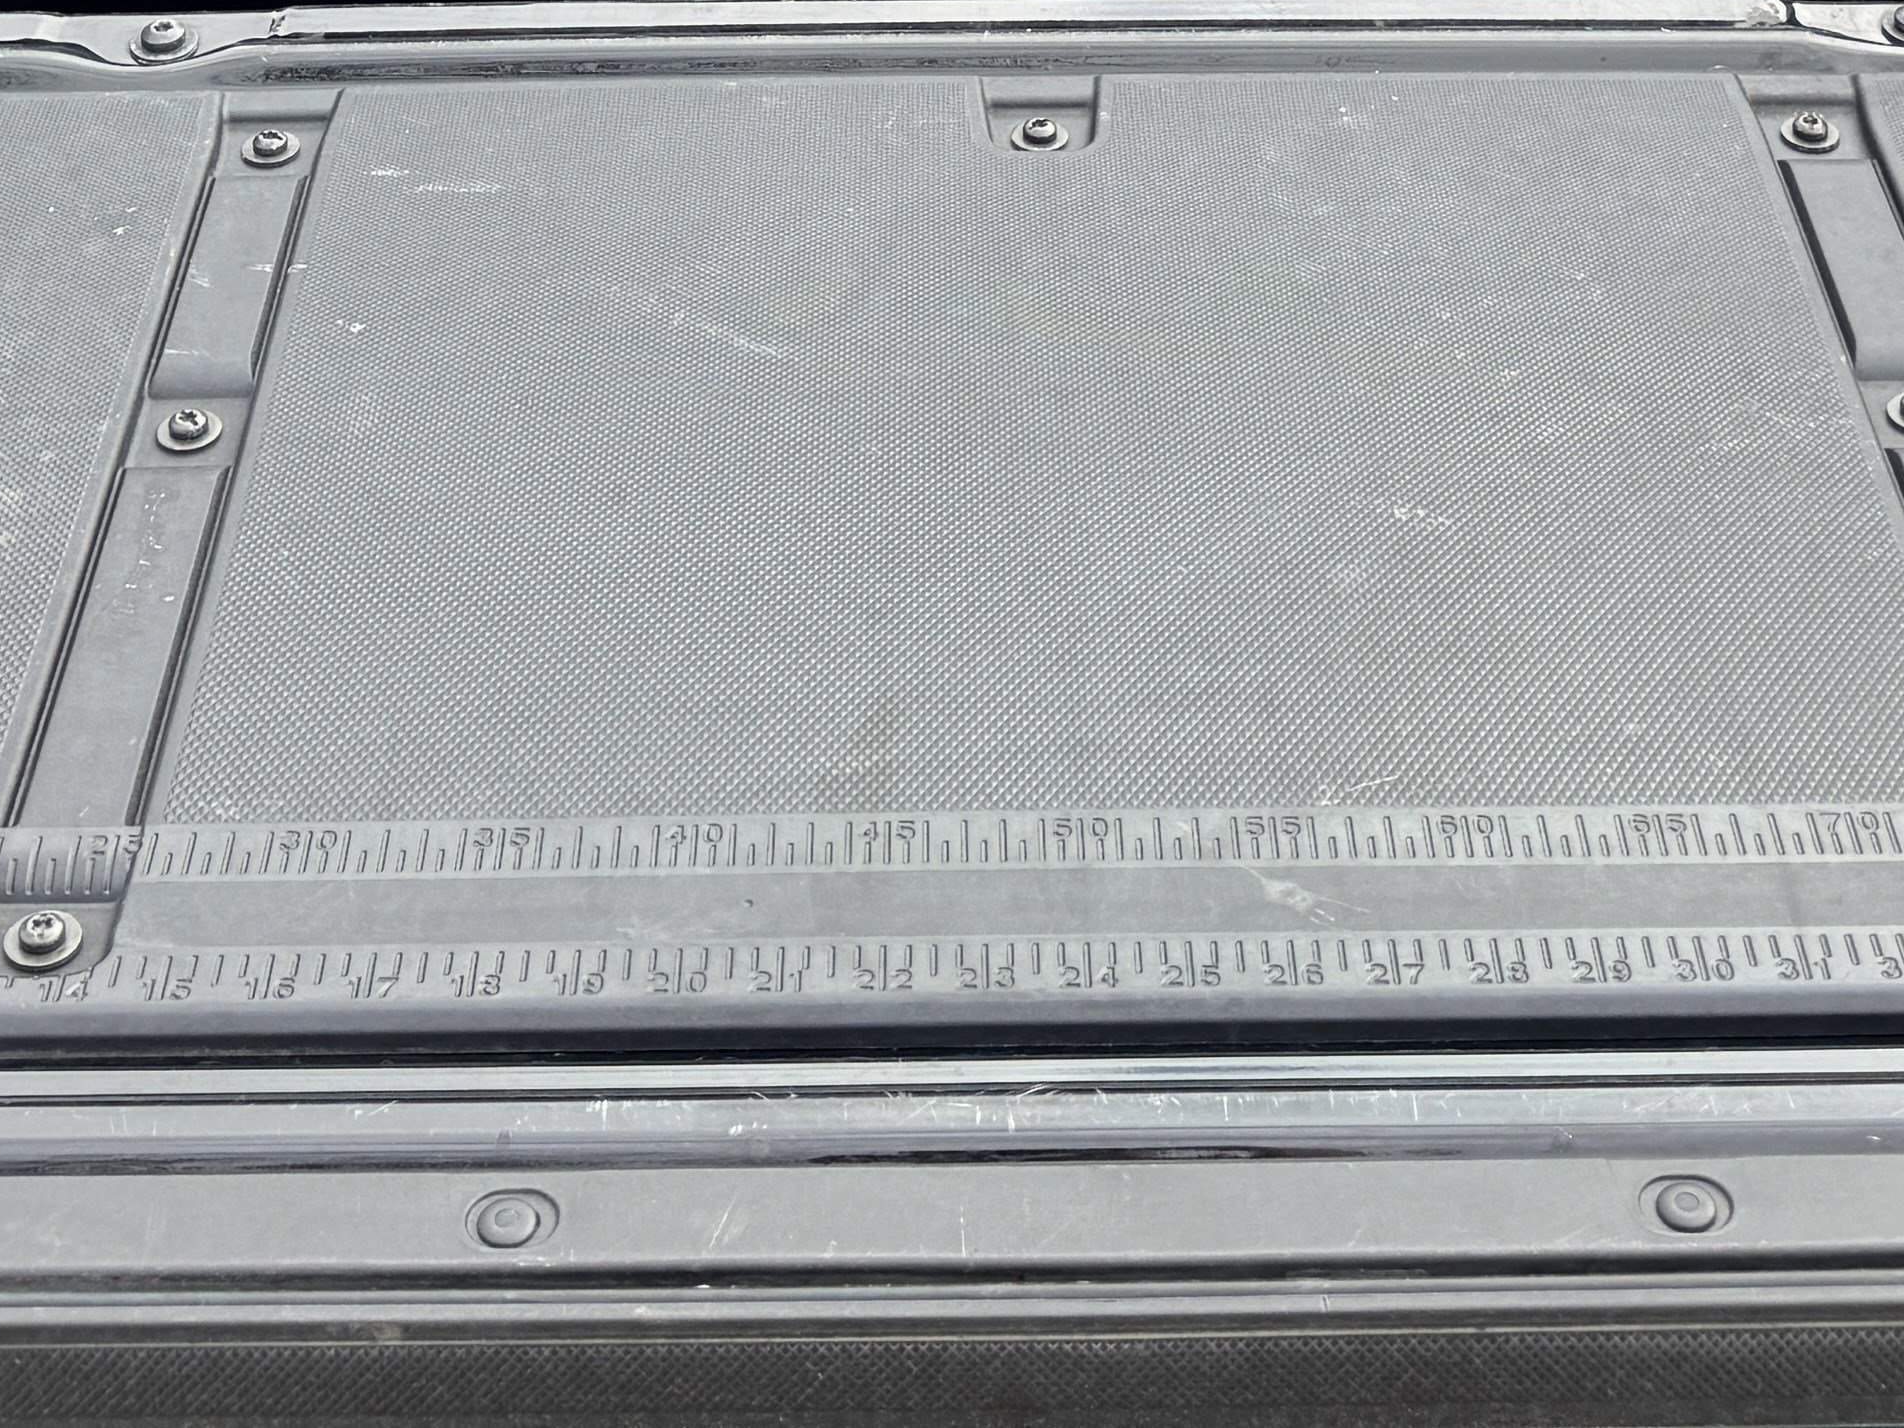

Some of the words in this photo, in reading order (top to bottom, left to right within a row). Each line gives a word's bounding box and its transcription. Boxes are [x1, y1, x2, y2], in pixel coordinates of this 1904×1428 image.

[89, 834, 141, 856] 25
[279, 830, 337, 850] 30
[472, 827, 530, 848] 35
[666, 824, 723, 844] 40
[863, 819, 916, 841] 45
[1053, 817, 1109, 838] 50
[1245, 815, 1302, 838] 55
[1437, 814, 1493, 836] 60
[1628, 813, 1687, 835] 65
[1818, 812, 1880, 834] 70
[39, 980, 90, 1002] 14
[142, 979, 193, 1002] 15
[245, 977, 296, 1000] 16
[347, 976, 399, 999] 17
[451, 975, 502, 997] 18
[553, 973, 605, 996] 19
[648, 972, 708, 995] 20
[748, 970, 802, 992] 21
[854, 969, 914, 991] 22
[959, 967, 1016, 989] 23
[1060, 966, 1119, 989] 24
[1162, 964, 1222, 987] 25
[1264, 963, 1324, 986] 26
[1366, 962, 1425, 985] 27
[1468, 961, 1530, 984] 28
[1571, 960, 1633, 983] 29
[1673, 958, 1736, 981] 30
[1776, 957, 1832, 980] 31
